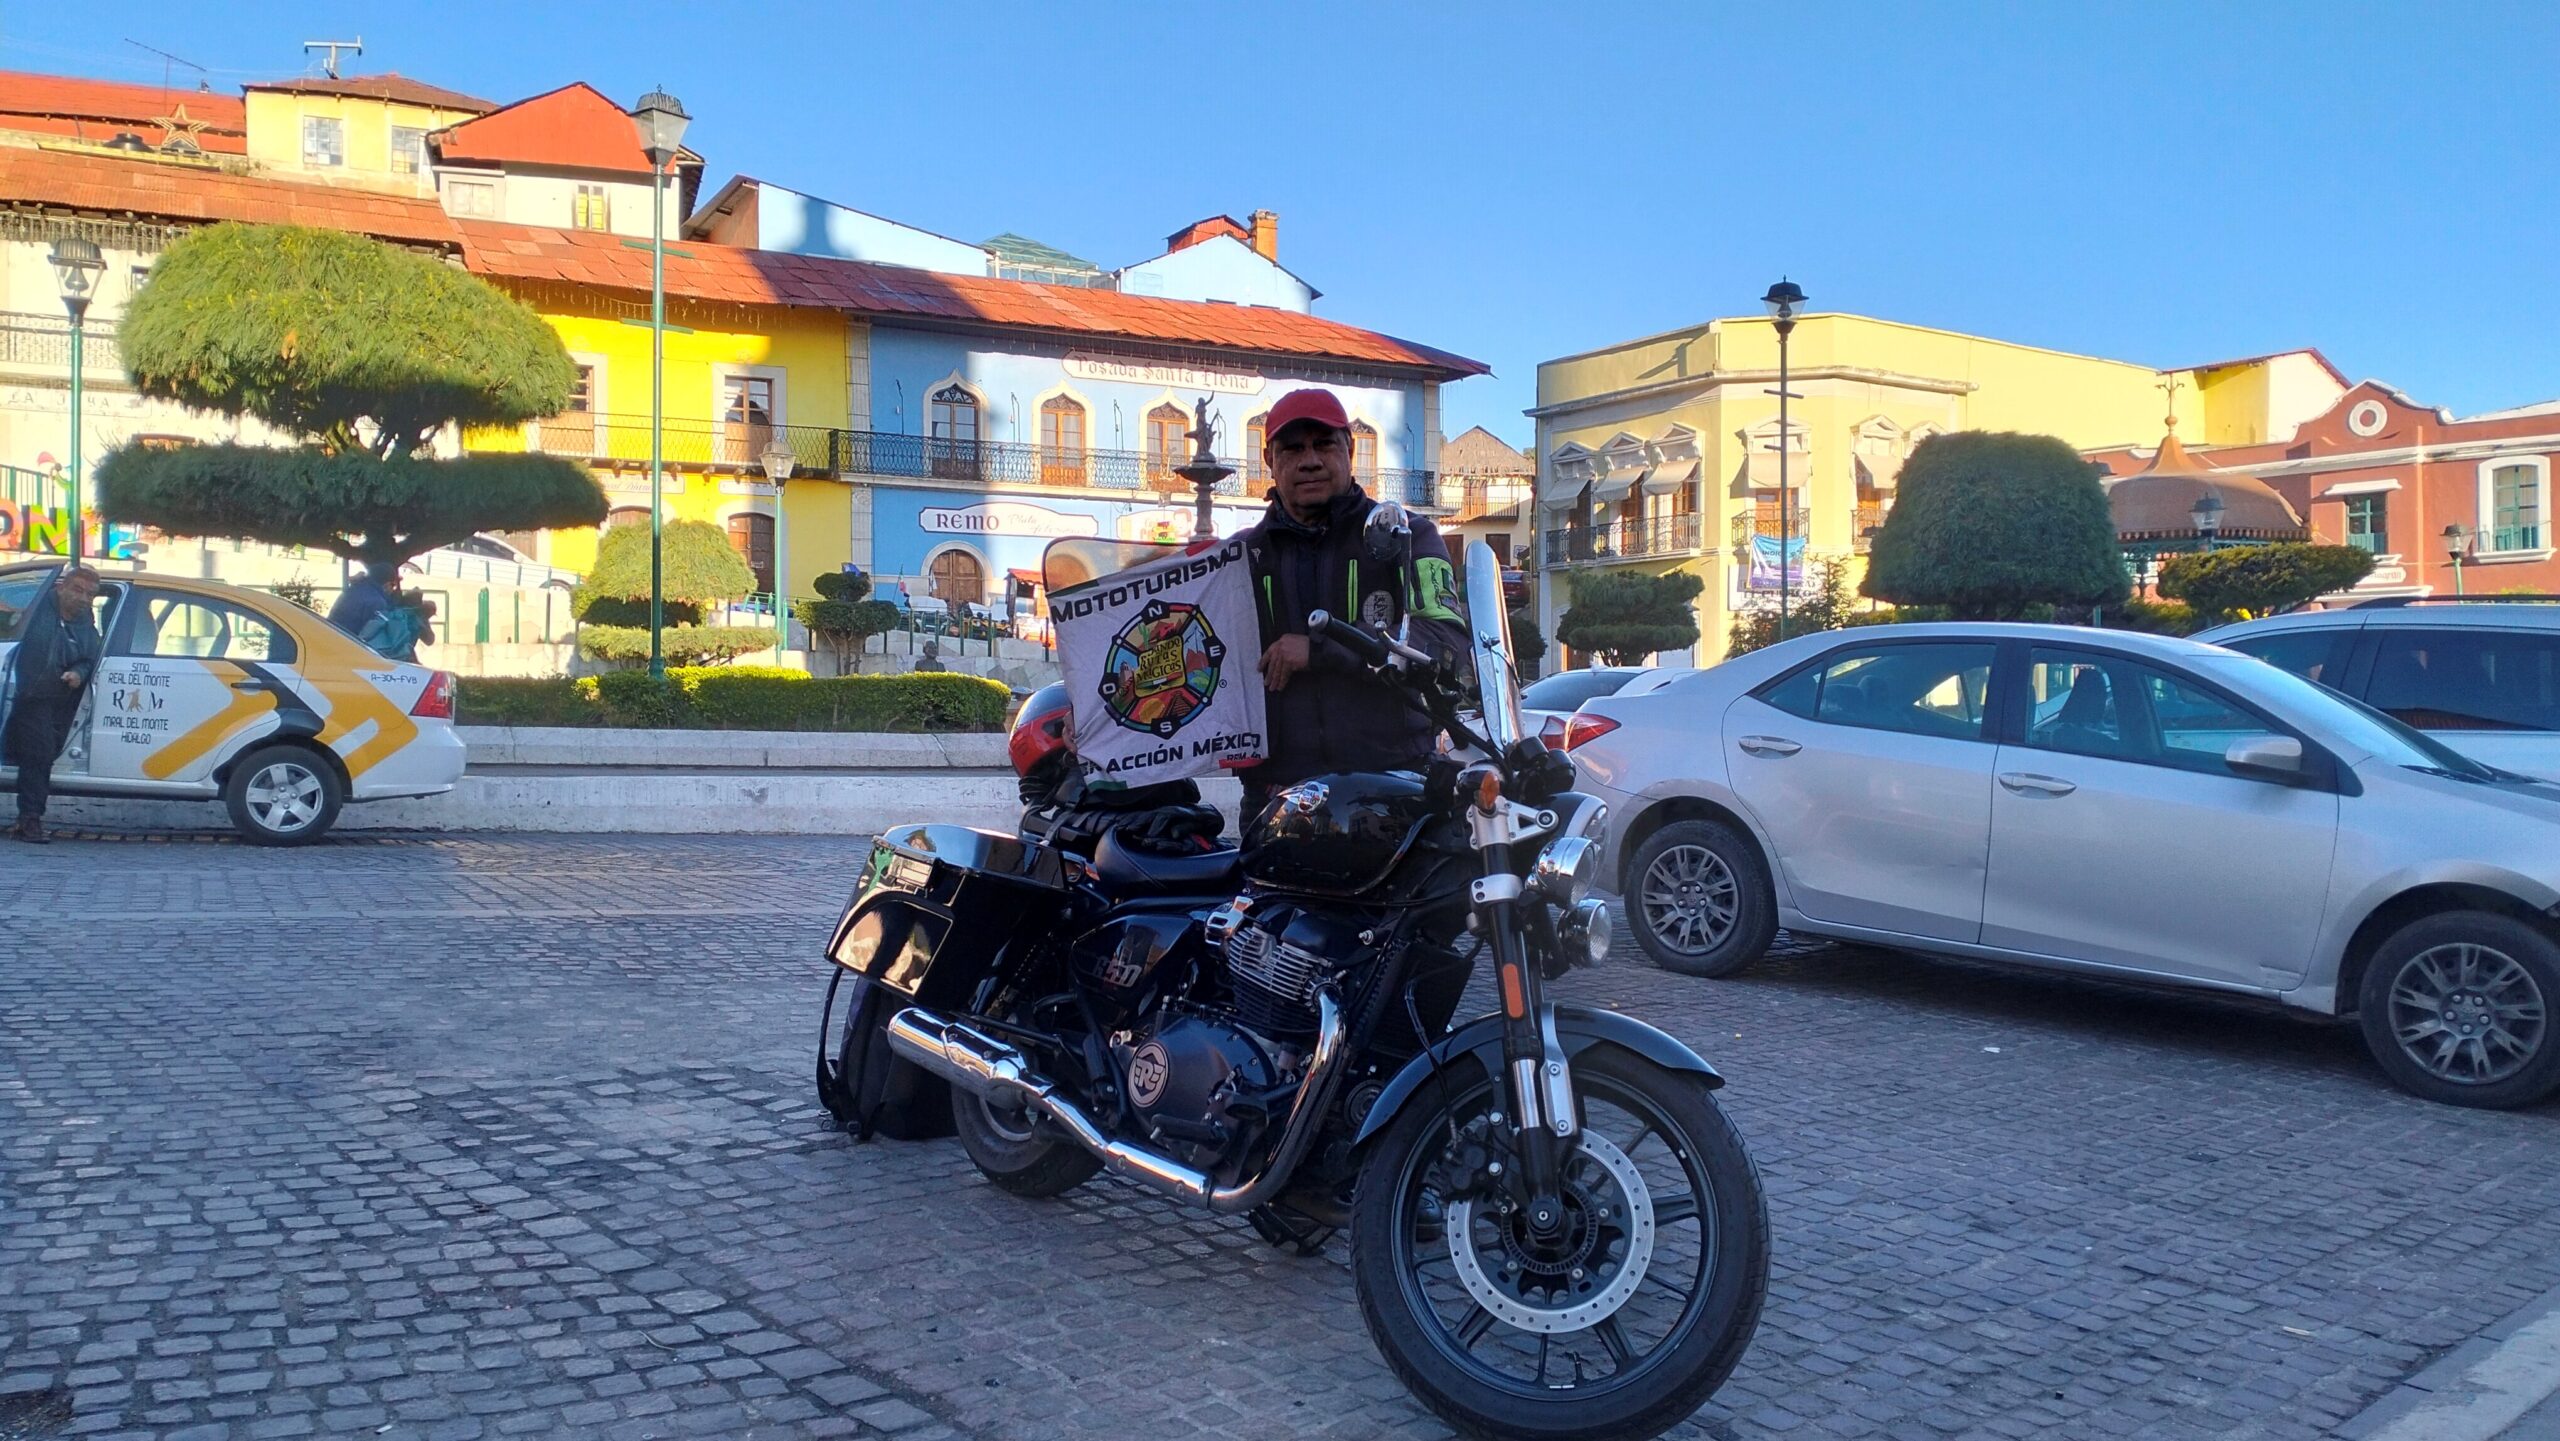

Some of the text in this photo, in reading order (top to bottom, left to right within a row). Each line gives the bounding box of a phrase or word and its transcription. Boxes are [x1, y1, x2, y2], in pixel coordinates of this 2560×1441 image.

[1074, 355, 1249, 389] Posada Santa Elena
[57, 393, 110, 408] JYA
[936, 513, 1000, 530] REMO
[1050, 540, 1242, 624] MOTOTURISMO
[1148, 605, 1163, 617] N
[1209, 645, 1221, 657] E
[132, 662, 150, 673] SITIO
[108, 673, 171, 687] REAL DEL MONTE
[1102, 682, 1116, 695] O
[112, 689, 124, 711] R
[127, 717, 140, 729] DEL
[141, 719, 169, 731] MONTE
[1160, 721, 1173, 733] S
[121, 732, 152, 744] HIDALGO
[1106, 744, 1184, 774] ACCIÓN
[1192, 731, 1261, 758] MÉXICO
